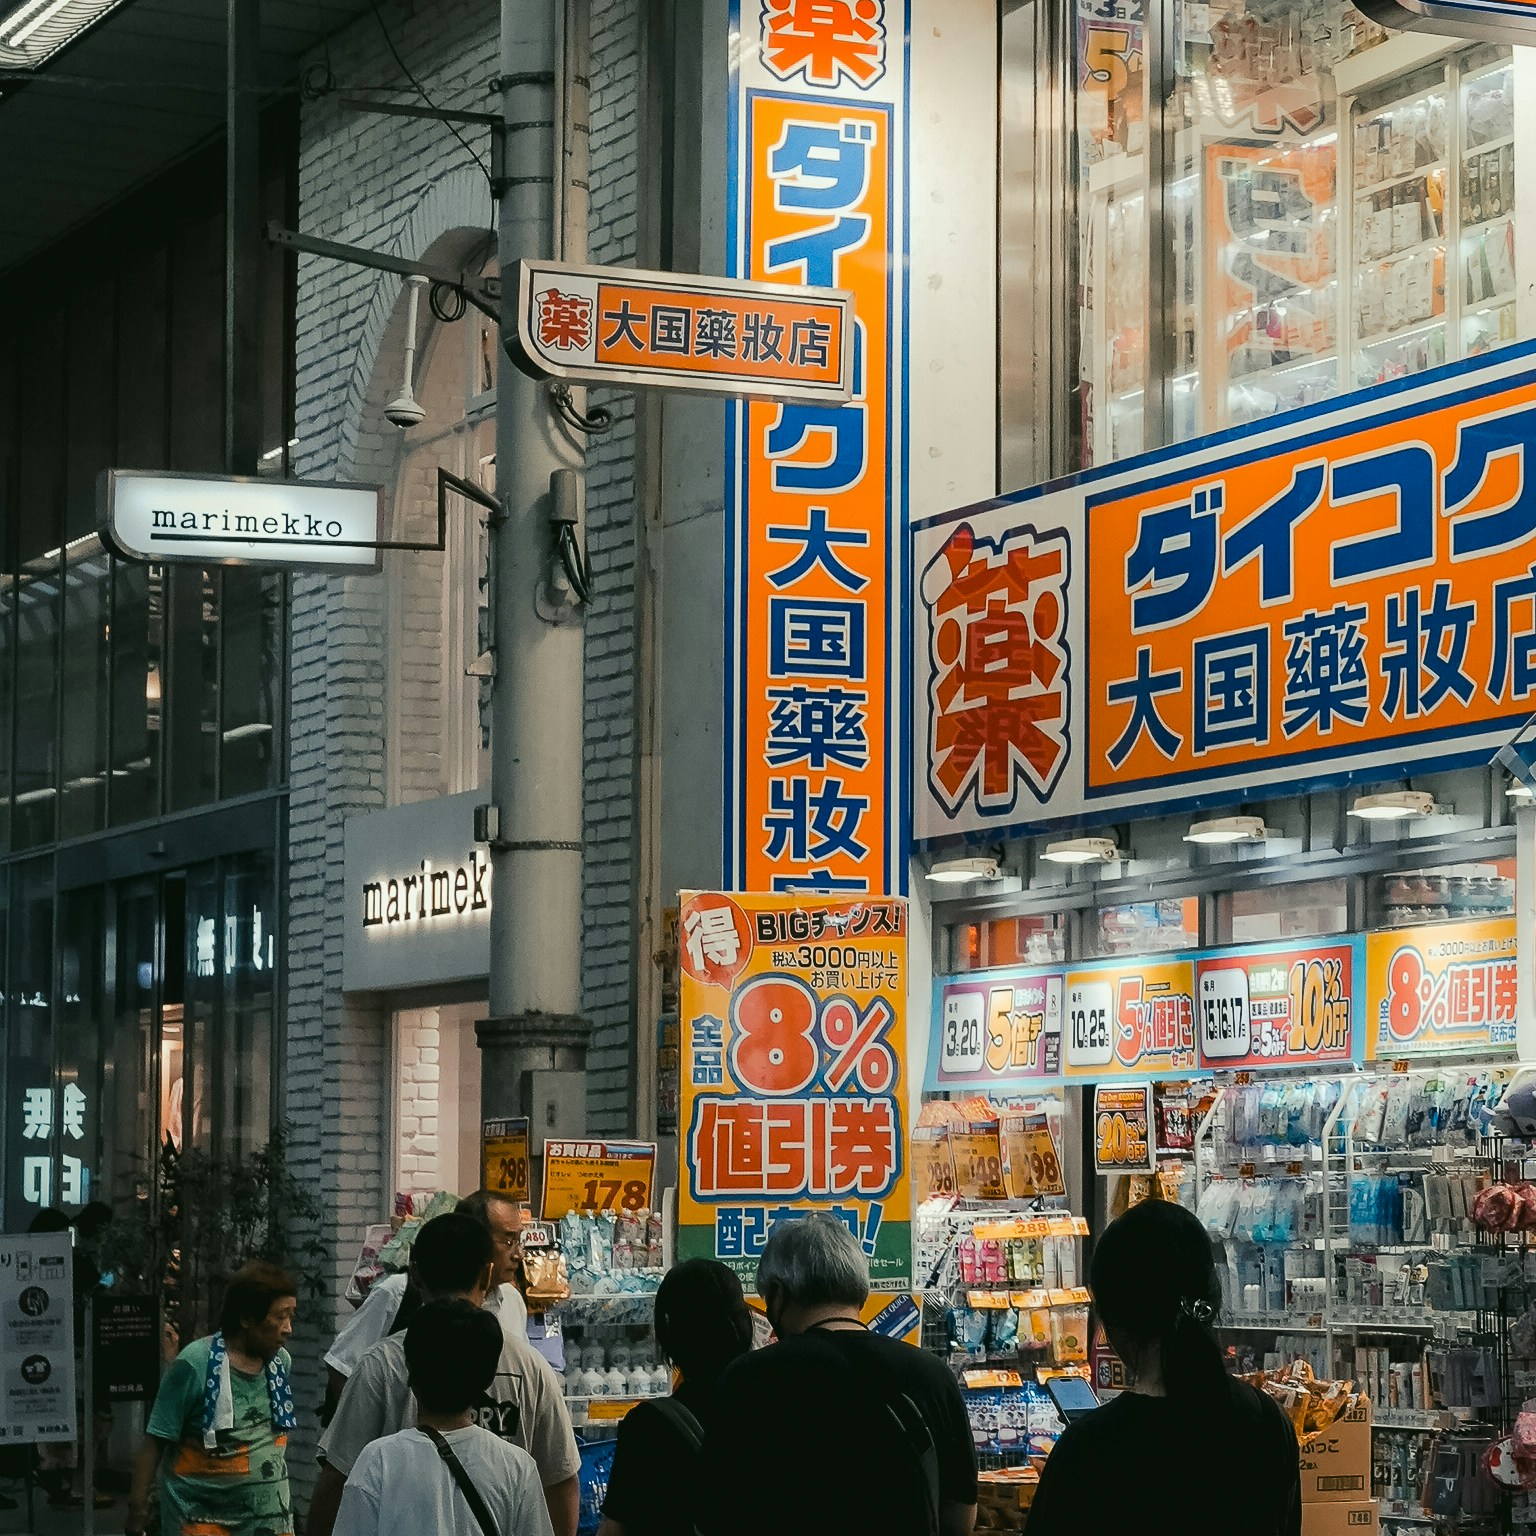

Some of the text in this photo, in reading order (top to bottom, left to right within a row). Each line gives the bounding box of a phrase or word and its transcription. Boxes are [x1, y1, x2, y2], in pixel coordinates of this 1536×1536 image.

[535, 288, 593, 351] 薬
[151, 504, 344, 538] marimekko
[921, 522, 1072, 818] 薬
[684, 908, 740, 971] 得
[772, 945, 899, 970] 税込3000円以上
[810, 970, 899, 991] お買い上げで
[691, 1015, 724, 1086] 全品
[731, 977, 895, 1097] 8%
[1171, 1052, 1194, 1066] セール
[695, 1097, 899, 1196] 値引券
[1098, 1112, 1127, 1164] 20
[1126, 1141, 1148, 1163] OFF
[498, 1156, 526, 1189] 298
[581, 1179, 647, 1210] 178
[1016, 1222, 1048, 1234] 288
